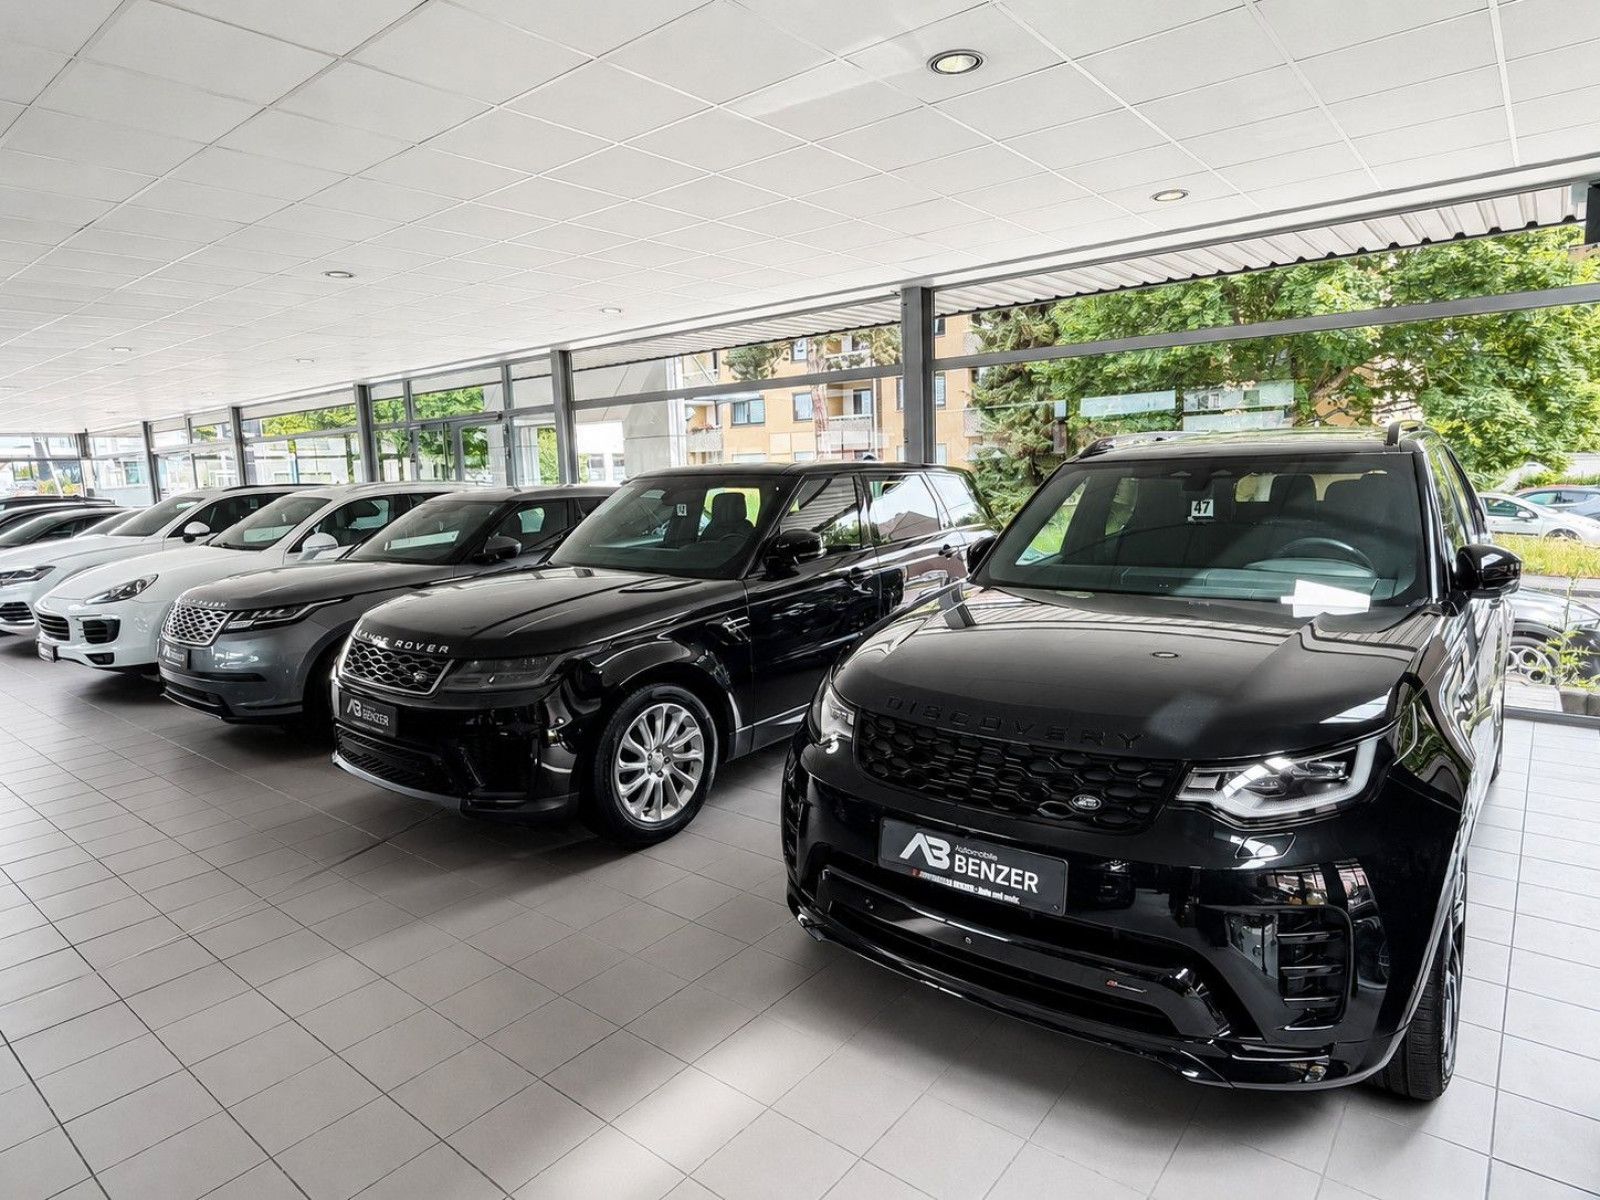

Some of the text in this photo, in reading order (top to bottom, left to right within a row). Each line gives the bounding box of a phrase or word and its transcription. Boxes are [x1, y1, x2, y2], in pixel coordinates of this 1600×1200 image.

[1194, 501, 1211, 515] 47
[394, 639, 450, 654] ROVER
[886, 695, 1145, 749] DISCOVERY
[899, 832, 951, 870] AB
[955, 844, 999, 862] Automobile
[954, 854, 1039, 894] BENZER
